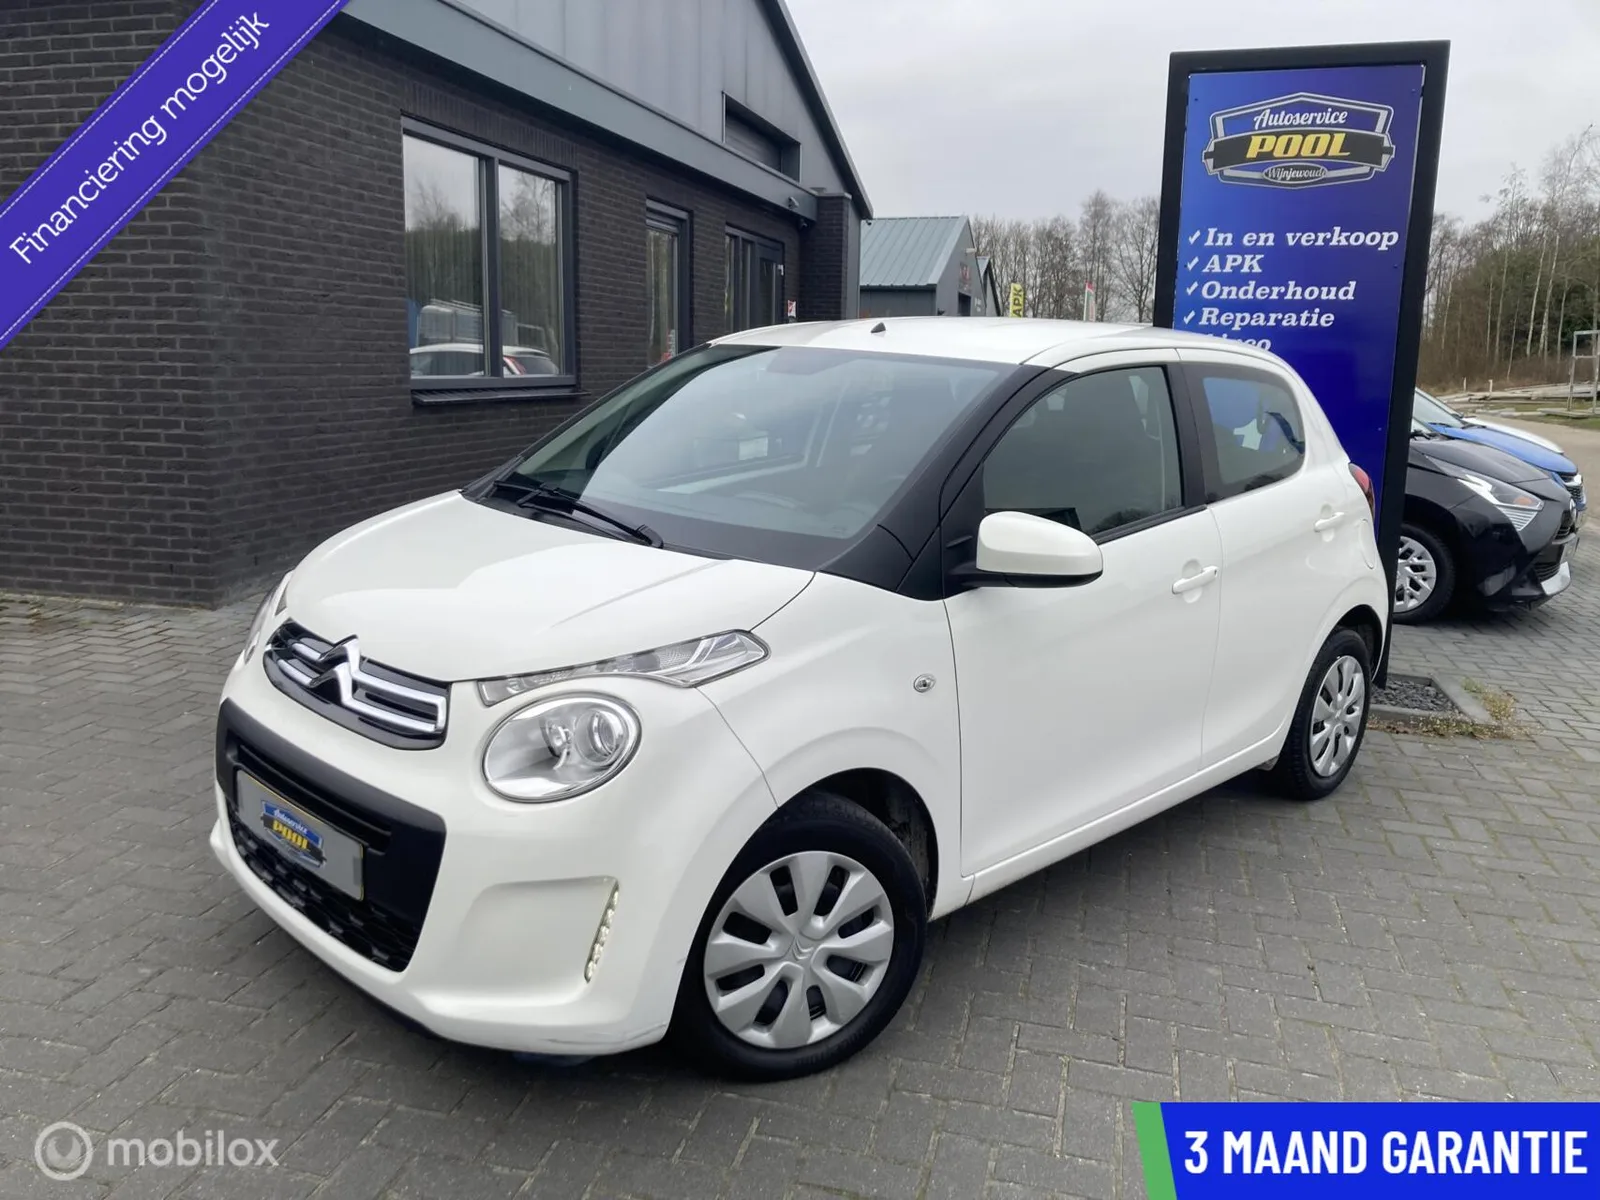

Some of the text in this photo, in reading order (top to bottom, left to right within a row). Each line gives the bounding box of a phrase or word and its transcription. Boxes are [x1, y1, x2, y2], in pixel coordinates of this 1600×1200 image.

[1254, 108, 1348, 130] Autoservice
[1246, 133, 1350, 158] POOL
[1203, 226, 1399, 250] In en verkoop
[1202, 254, 1264, 272] APK
[1201, 281, 1356, 300] Onderhoud
[1198, 307, 1334, 330] Reparatie
